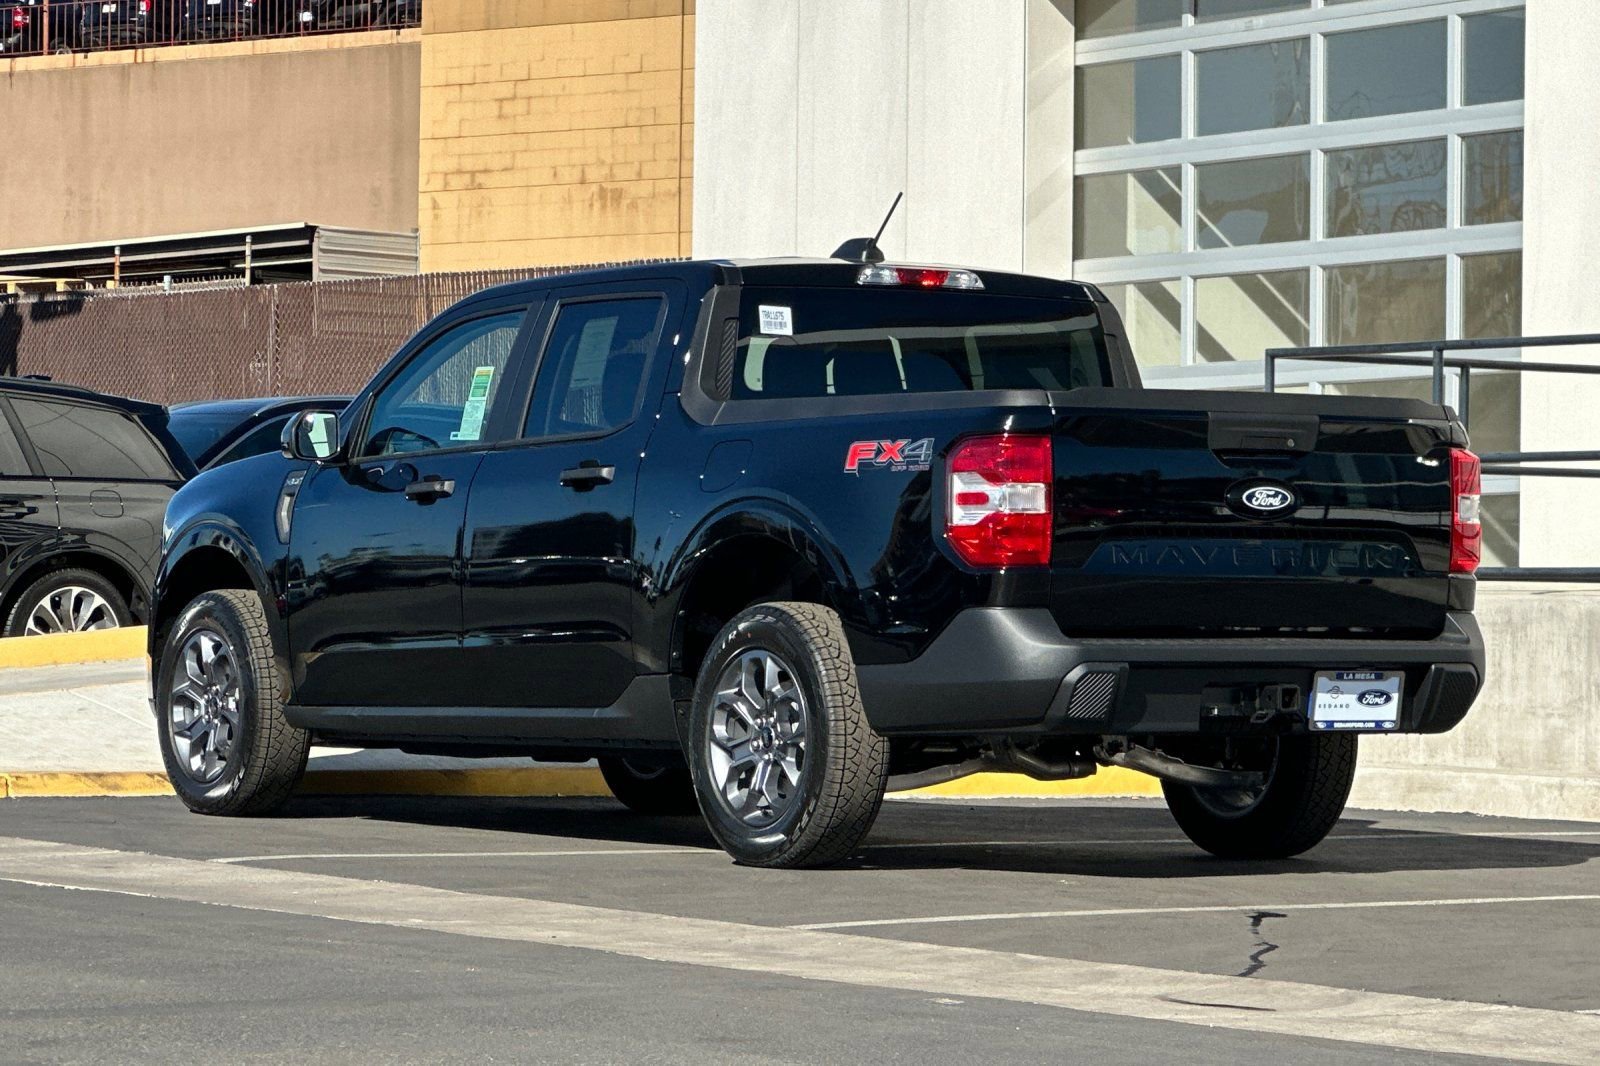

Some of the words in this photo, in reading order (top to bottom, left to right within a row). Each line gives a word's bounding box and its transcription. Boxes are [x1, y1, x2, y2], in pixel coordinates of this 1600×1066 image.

[844, 438, 935, 473] FX4
[1251, 490, 1282, 506] Ford
[1111, 544, 1397, 568] MAVERICK
[1362, 692, 1387, 704] Ford
